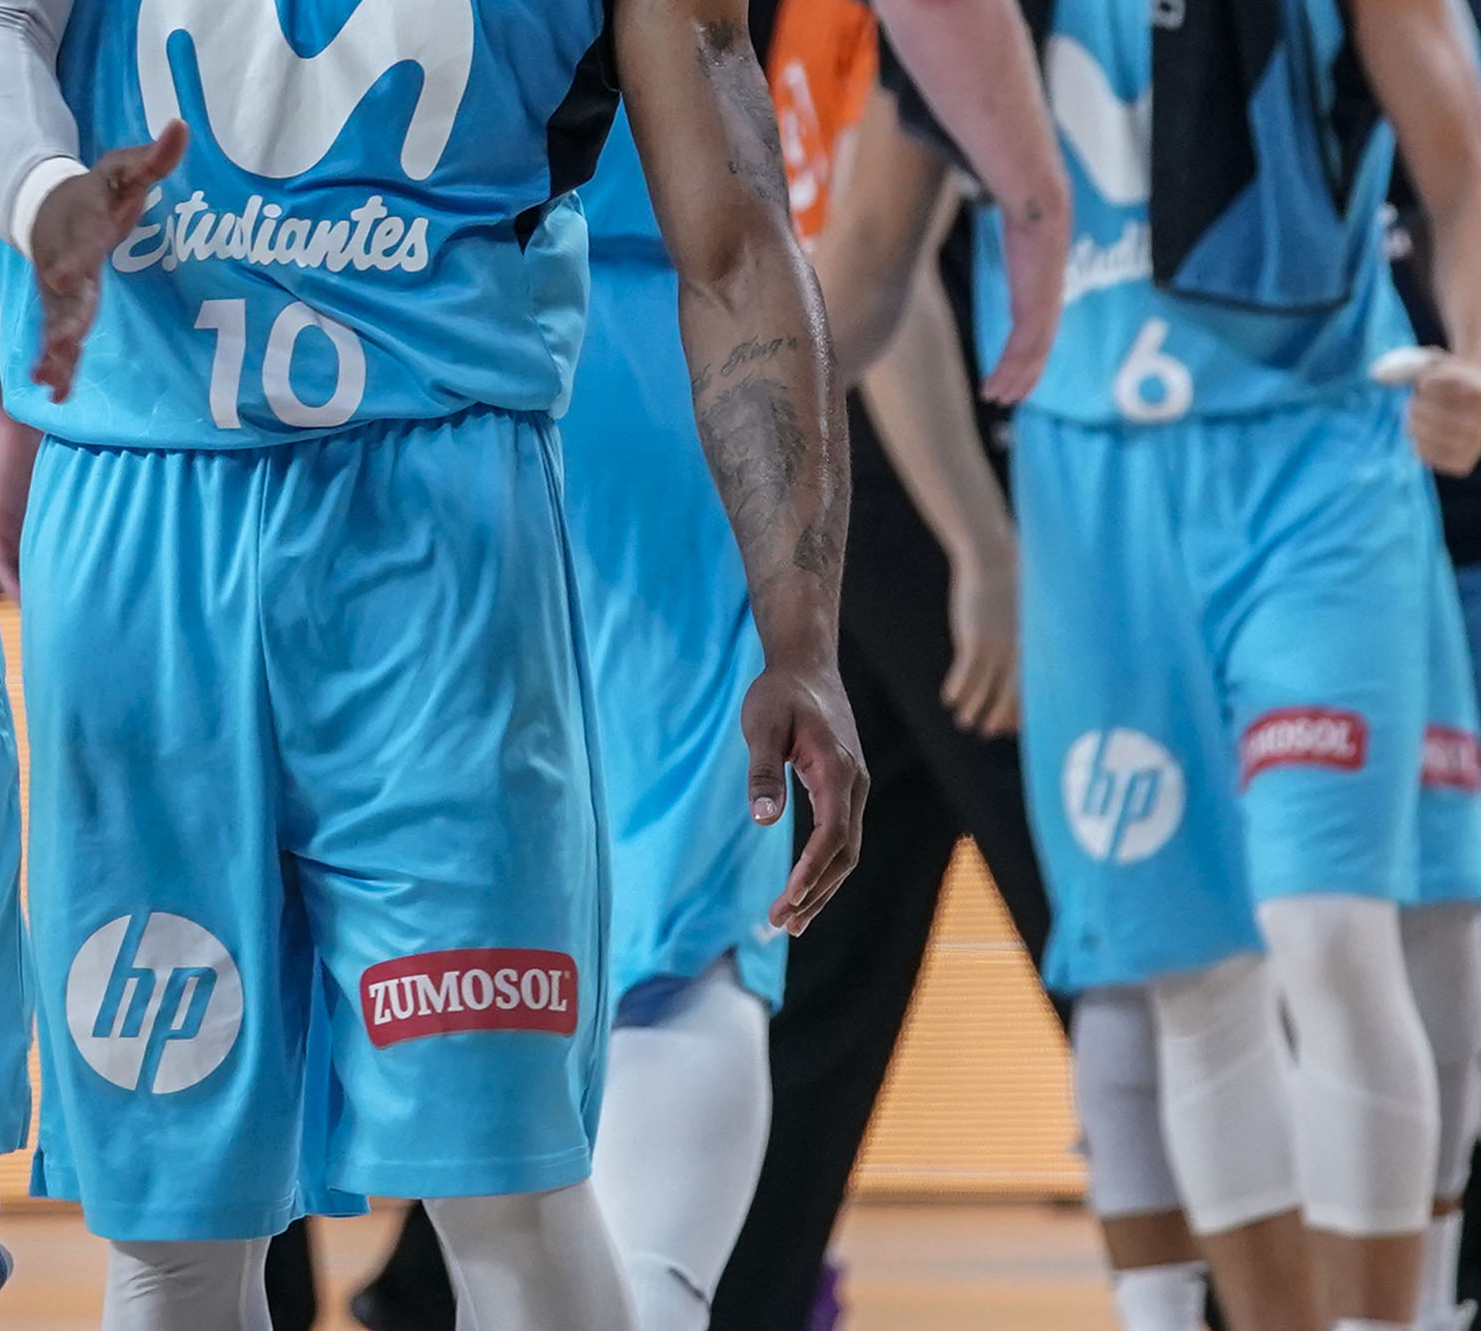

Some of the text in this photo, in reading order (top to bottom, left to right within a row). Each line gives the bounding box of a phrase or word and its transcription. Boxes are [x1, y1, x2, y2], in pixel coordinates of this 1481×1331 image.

[111, 186, 430, 273] Estudiantes
[193, 299, 367, 430] 10
[1114, 317, 1194, 425] 6
[1075, 727, 1165, 862] hp
[91, 911, 219, 1095] hp
[369, 968, 568, 1026] ZUMOSOL
